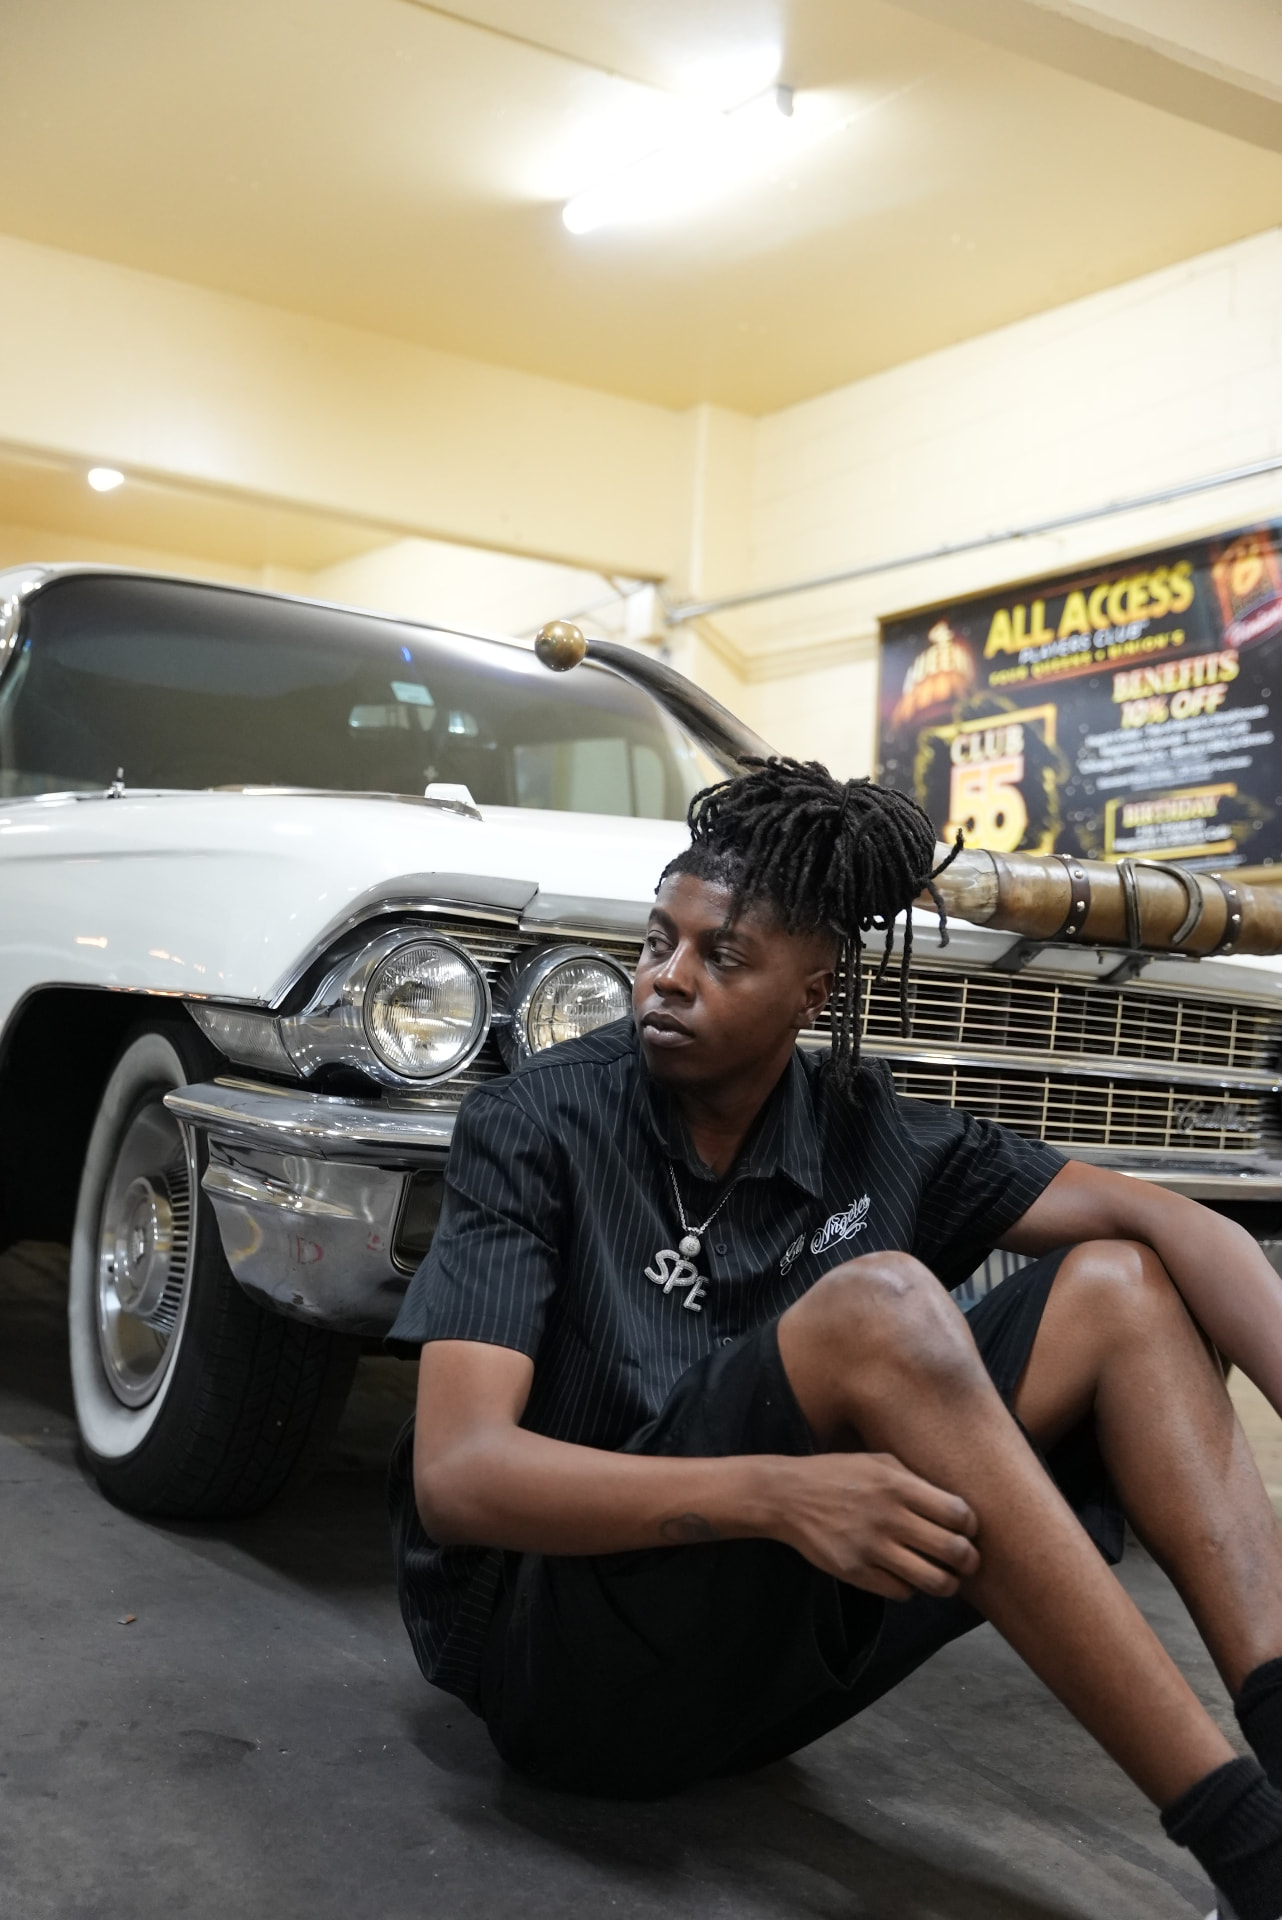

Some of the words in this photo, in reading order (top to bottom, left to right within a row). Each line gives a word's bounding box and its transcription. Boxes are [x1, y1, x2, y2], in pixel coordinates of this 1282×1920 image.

[983, 599, 1055, 659] ALL
[1057, 559, 1195, 638] ACCESS
[1111, 649, 1240, 703] BENEFITS
[1170, 683, 1229, 720] OFF
[951, 724, 1025, 765] CLUB
[643, 1249, 709, 1312] SPE
